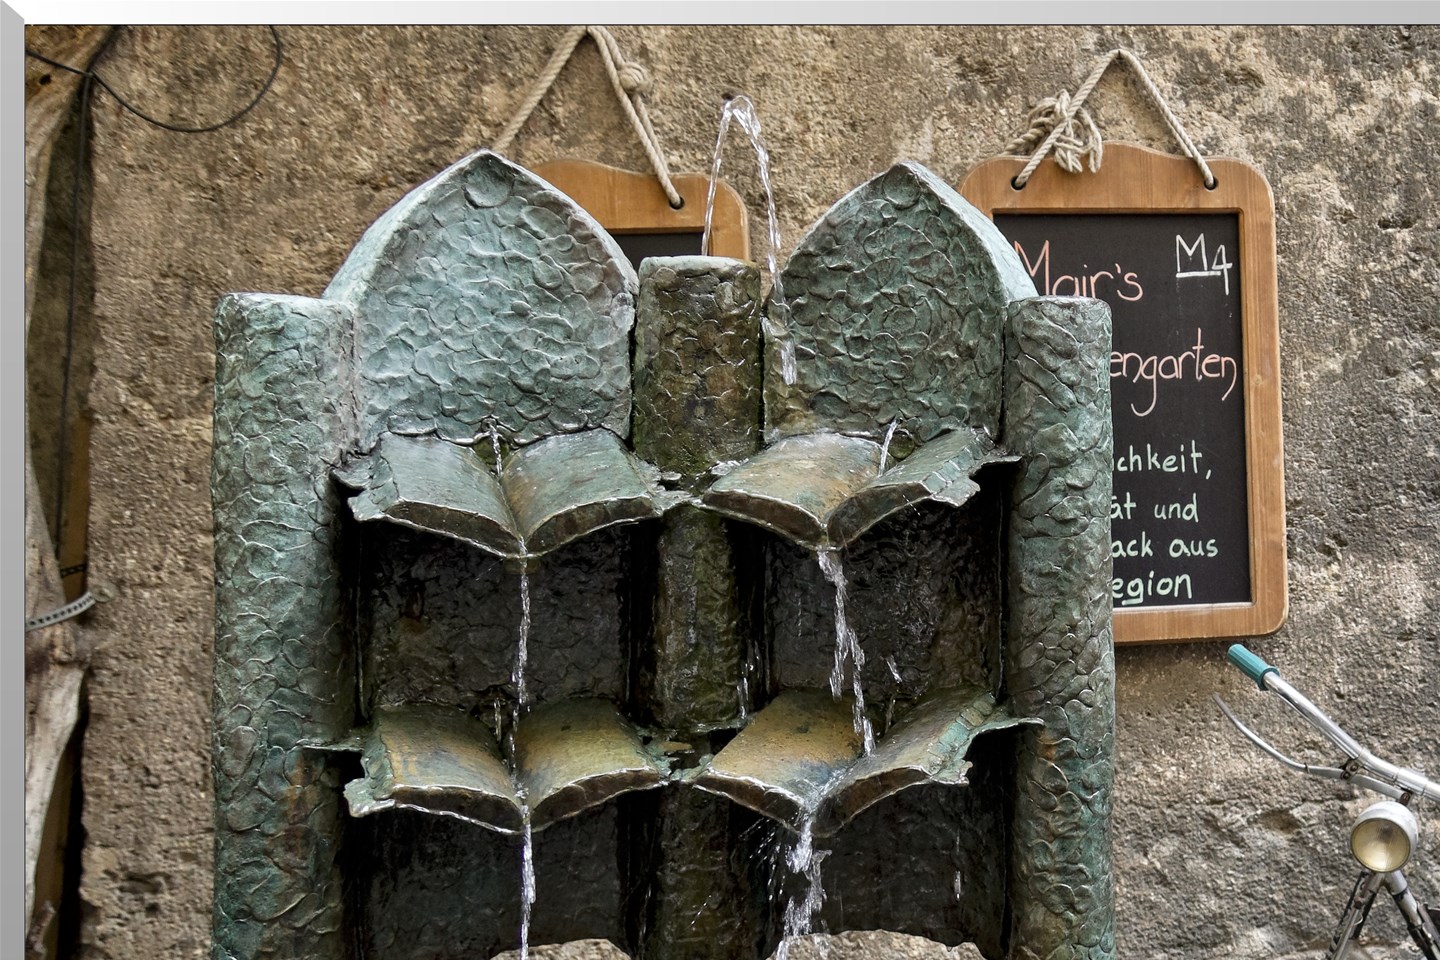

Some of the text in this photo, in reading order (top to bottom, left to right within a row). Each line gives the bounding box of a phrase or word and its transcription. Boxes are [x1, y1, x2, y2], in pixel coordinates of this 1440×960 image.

[1014, 240, 1144, 301] Mair's
[1110, 327, 1238, 417] engarten
[1153, 492, 1199, 523] und
[1110, 530, 1219, 558] ack aus
[1111, 569, 1193, 606] egion
